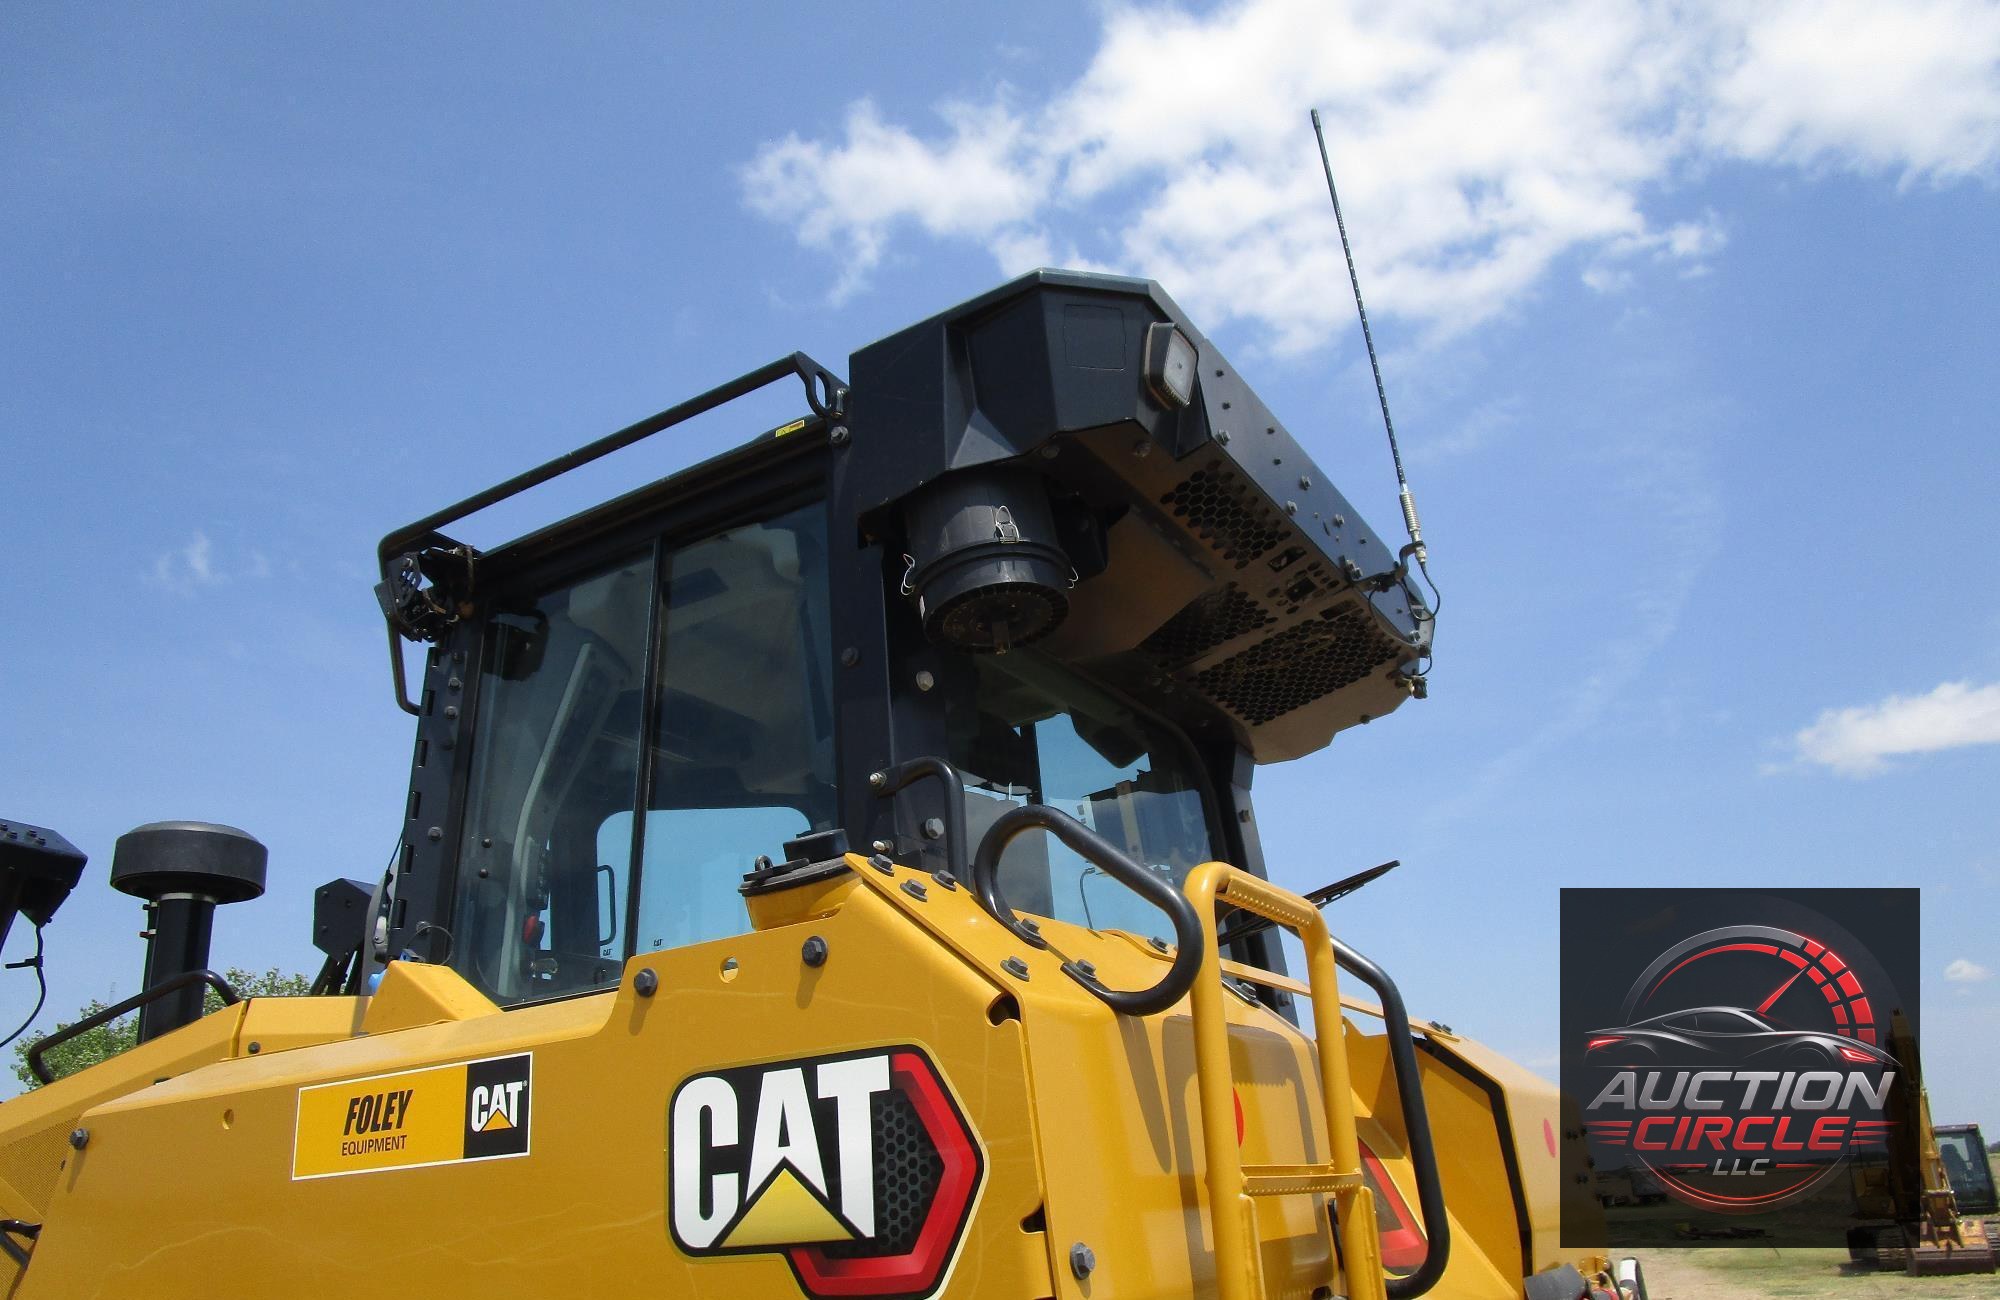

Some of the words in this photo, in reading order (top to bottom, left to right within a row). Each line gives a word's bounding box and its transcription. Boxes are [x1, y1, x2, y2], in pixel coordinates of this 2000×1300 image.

[343, 1089, 414, 1135] FOLEY
[341, 1135, 407, 1156] EQUIPMENT
[673, 1055, 890, 1248] CAT
